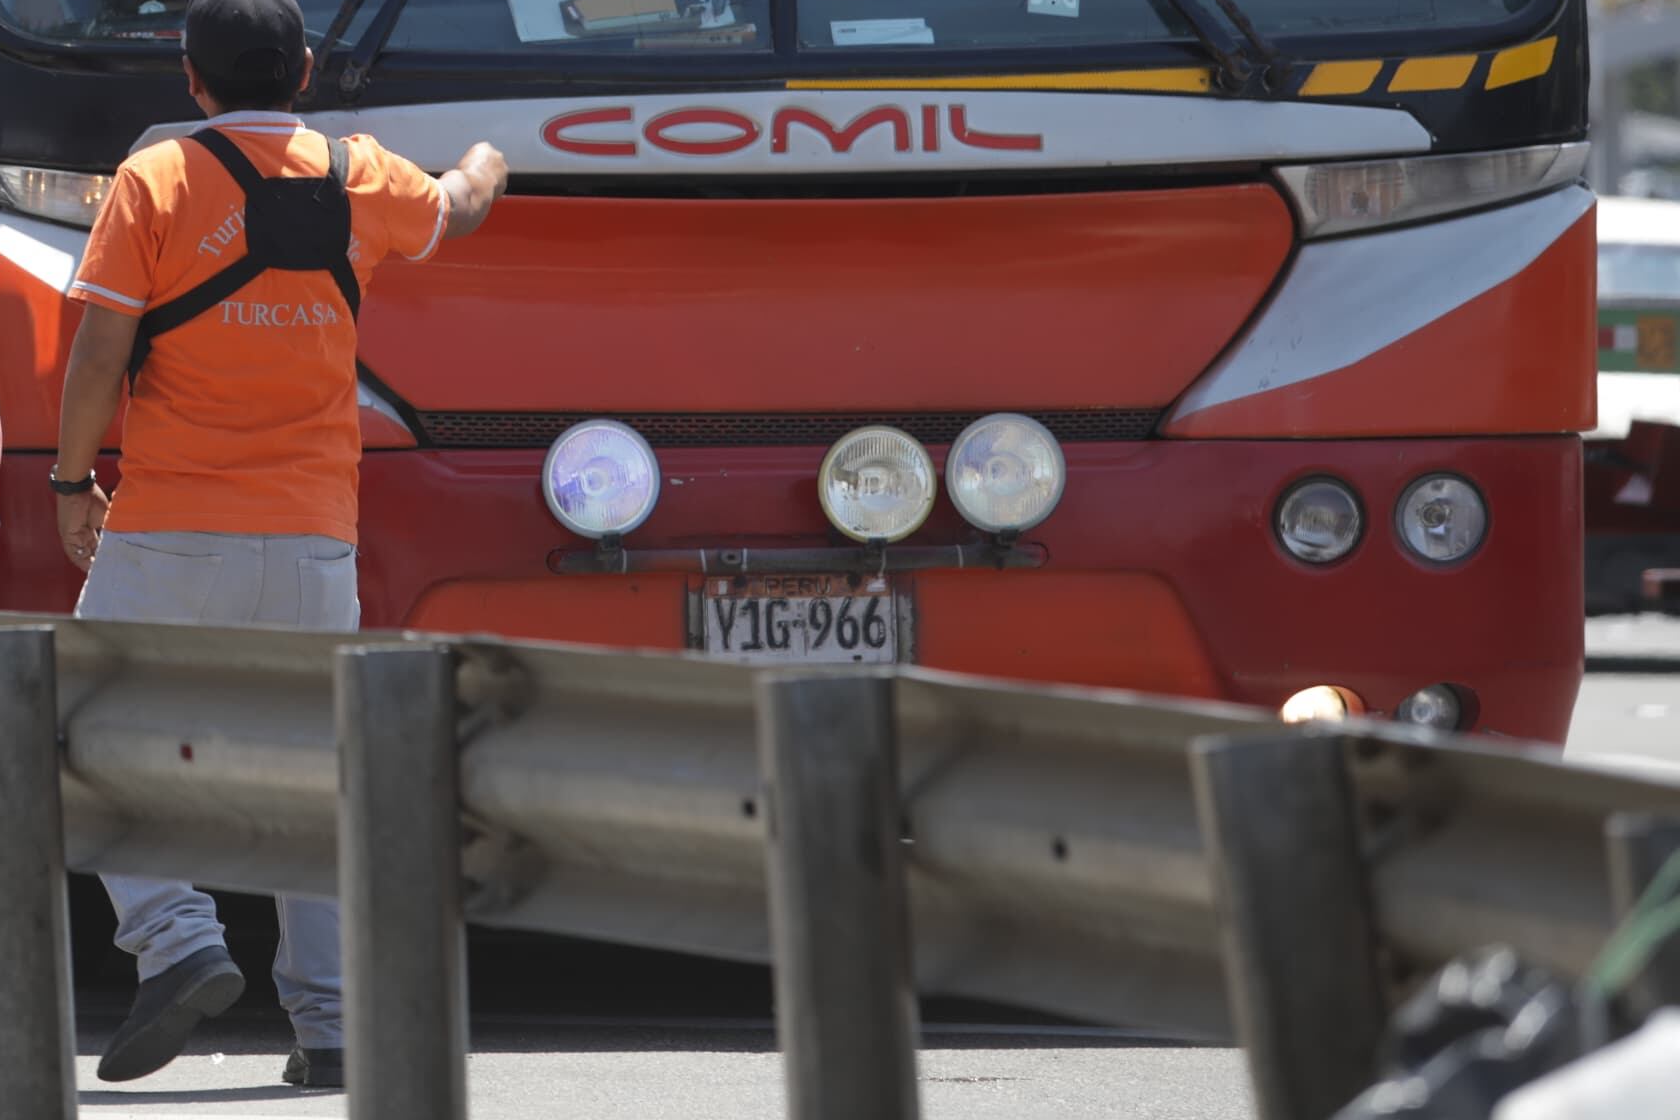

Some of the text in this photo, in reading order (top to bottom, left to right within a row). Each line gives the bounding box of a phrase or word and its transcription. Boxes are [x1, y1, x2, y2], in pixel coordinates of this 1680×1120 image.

[539, 103, 1044, 157] COMIL
[219, 300, 338, 327] TURCASA
[713, 595, 887, 651] Y1G-966
